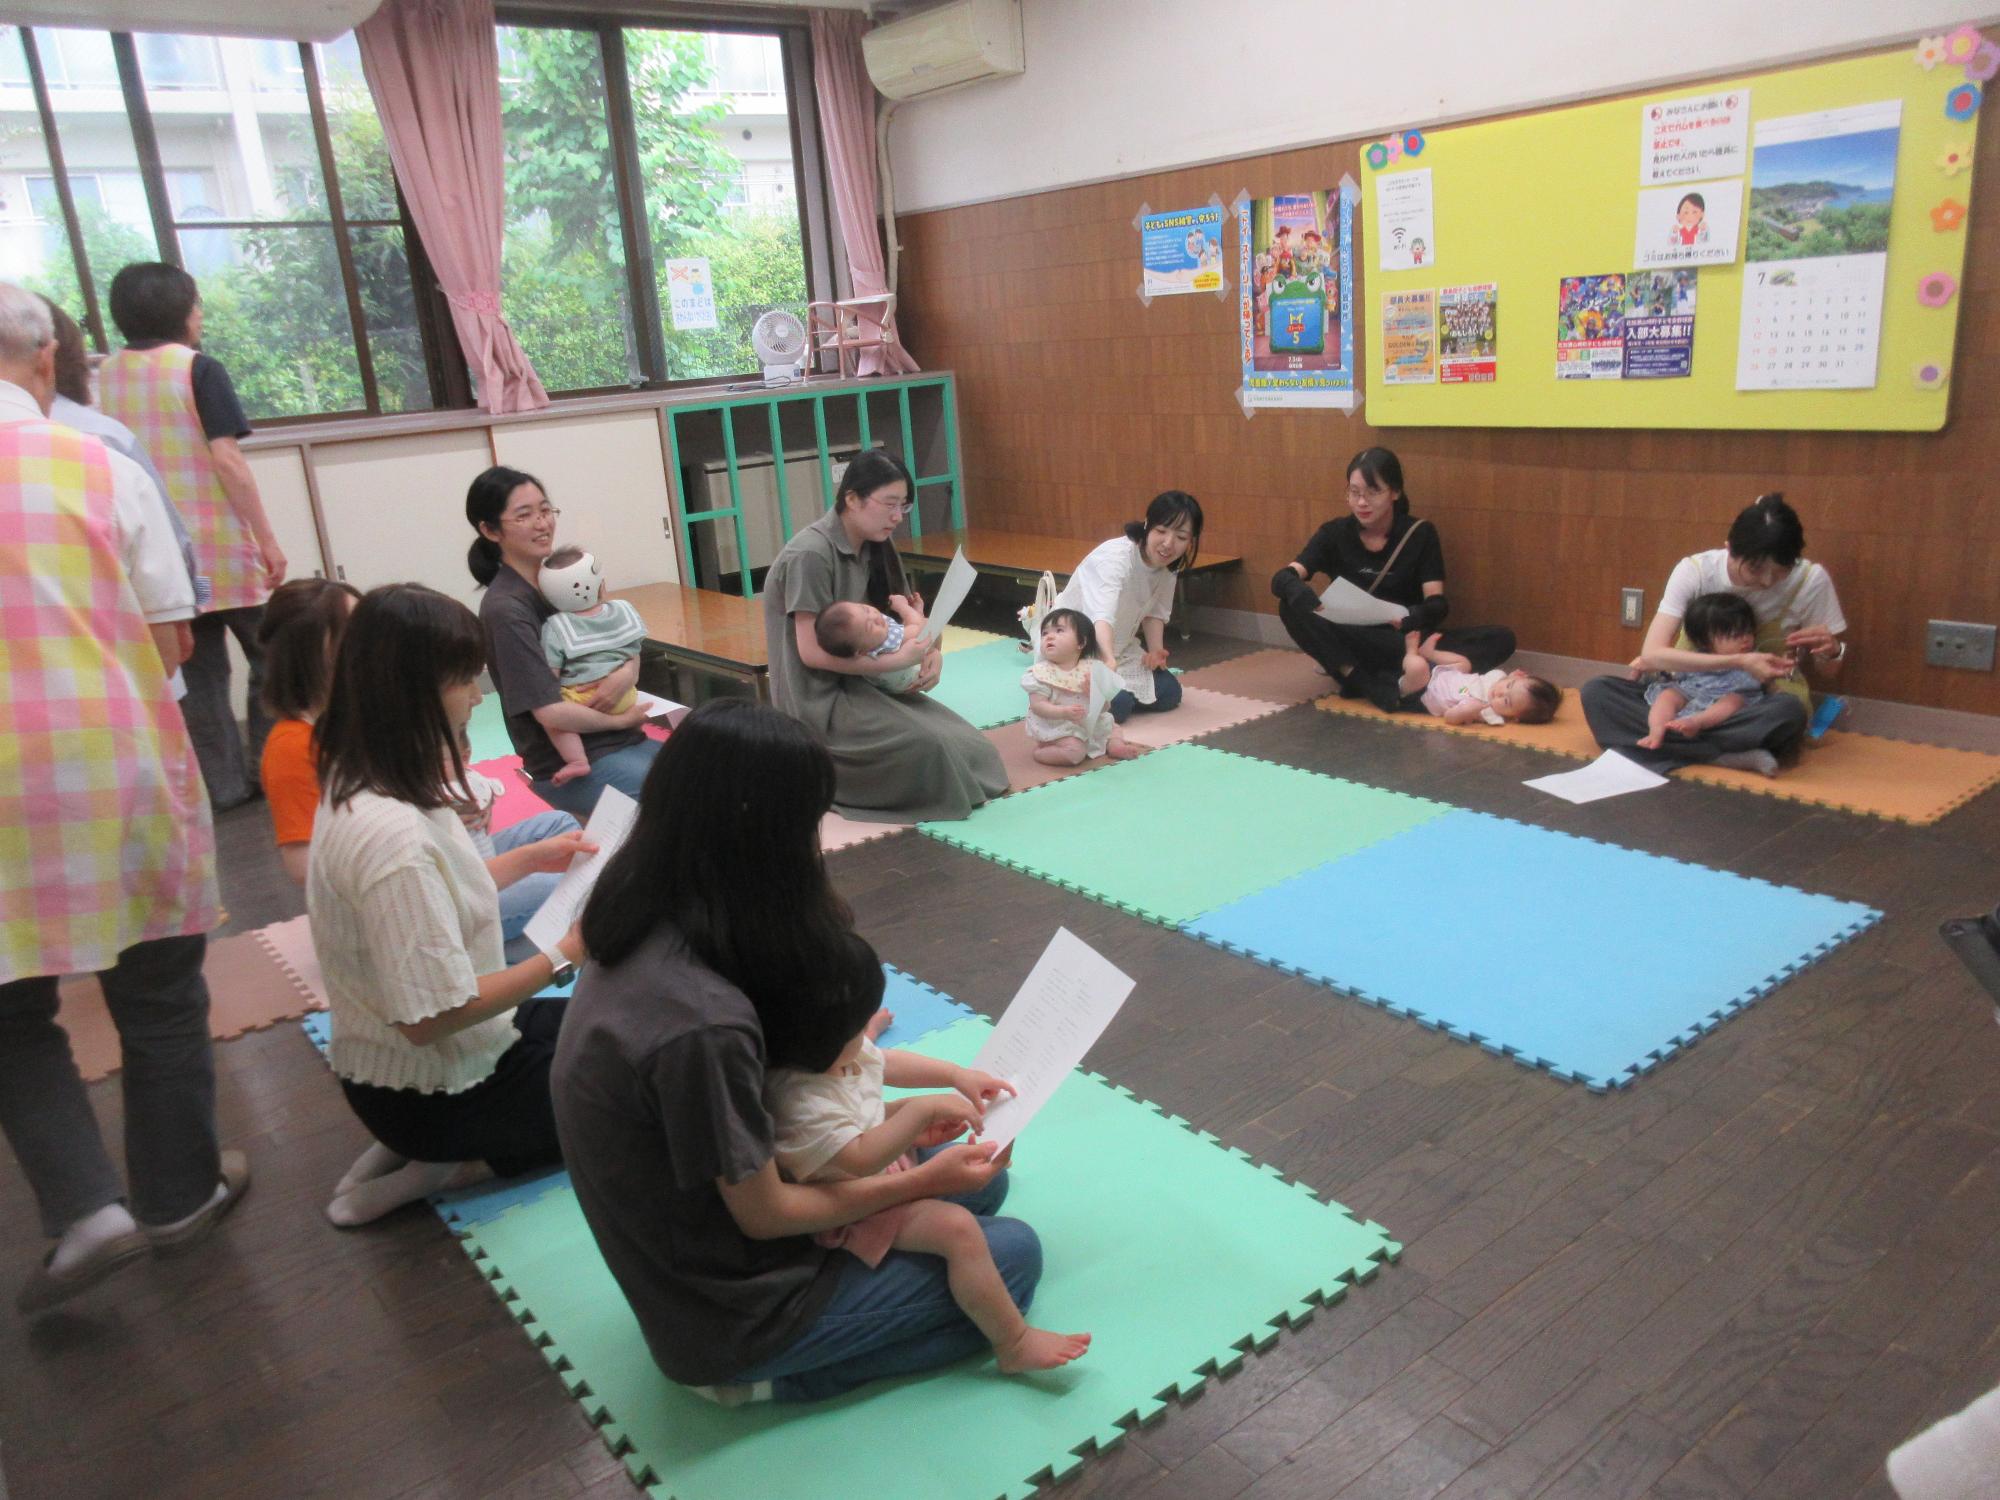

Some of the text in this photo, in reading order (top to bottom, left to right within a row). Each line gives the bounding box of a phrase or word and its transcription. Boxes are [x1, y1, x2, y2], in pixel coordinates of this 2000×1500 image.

[1757, 272, 1766, 286] 7
[1293, 332, 1300, 344] 5
[1626, 324, 1691, 340] 入部大募集!!
